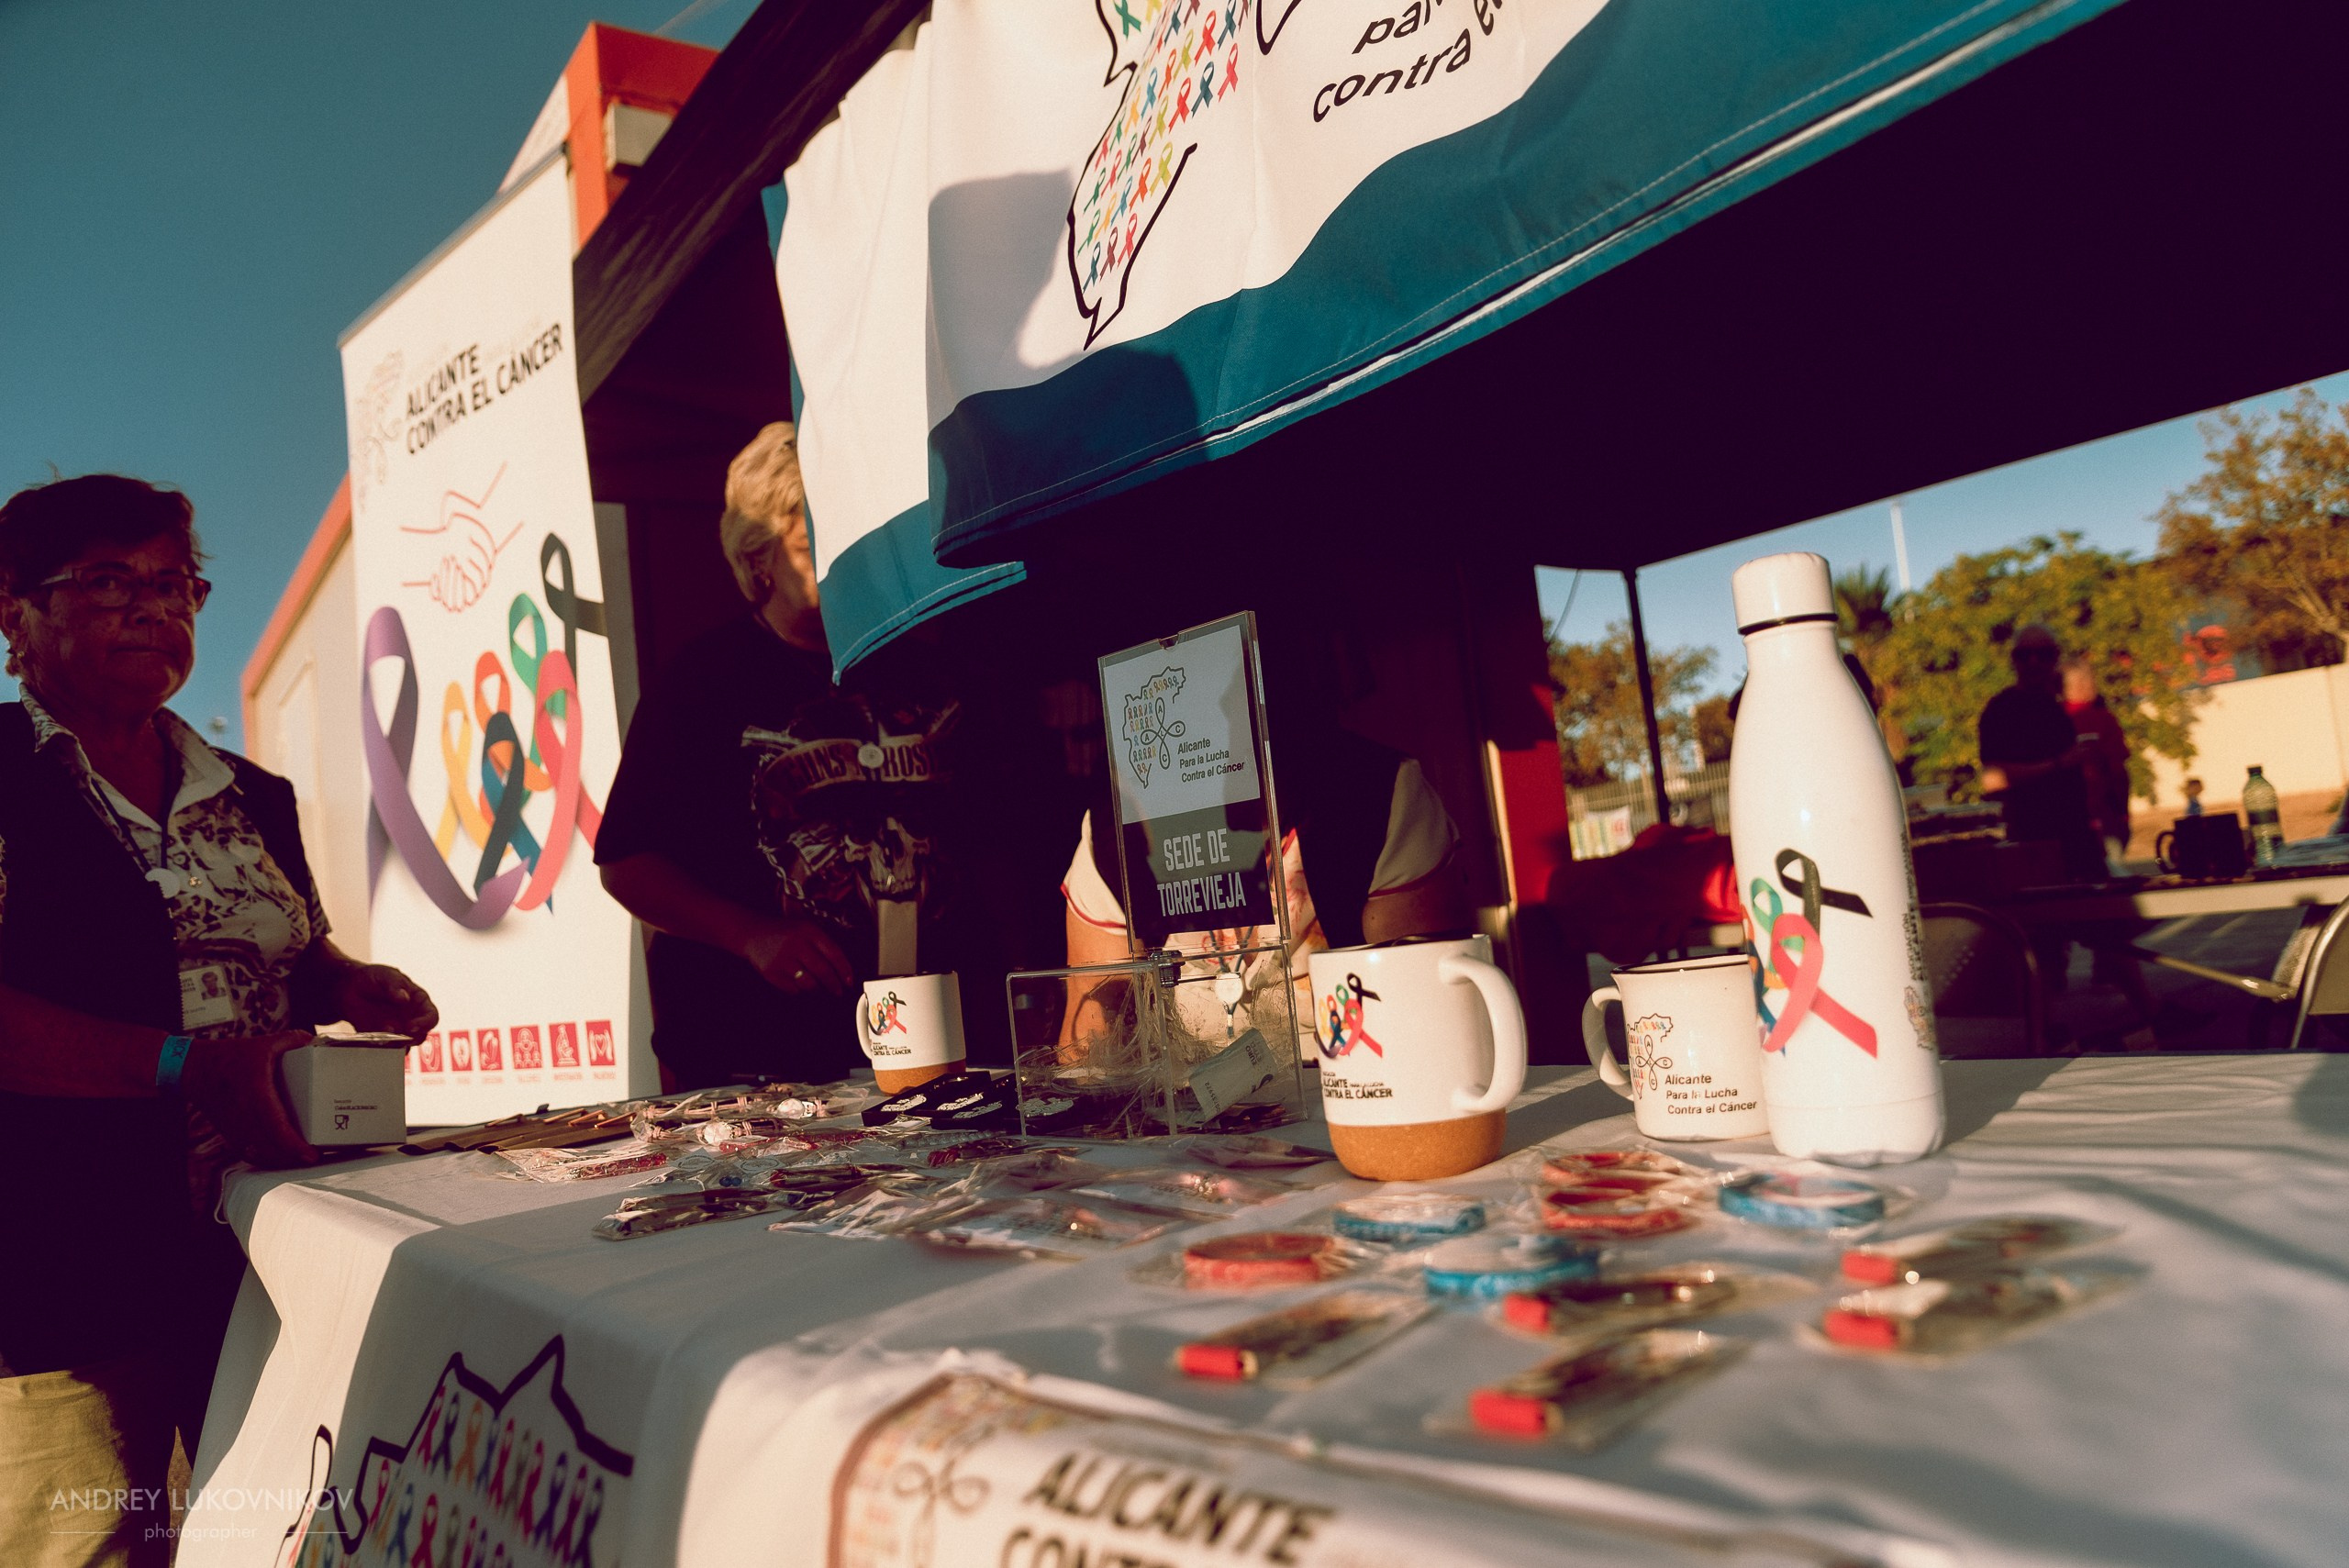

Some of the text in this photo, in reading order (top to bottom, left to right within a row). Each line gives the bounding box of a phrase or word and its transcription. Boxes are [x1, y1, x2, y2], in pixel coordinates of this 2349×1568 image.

[1352, 0, 1442, 54] par
[1313, 28, 1471, 123] contra
[406, 343, 479, 416] ALICANTE
[406, 390, 466, 454] CONTRA
[472, 375, 492, 412] EL
[1177, 738, 1210, 754] Alicante
[1180, 750, 1230, 769] Para la Lucha
[1182, 762, 1244, 783] Contra el Cáncer
[1163, 828, 1230, 872] SEDE DE
[1157, 872, 1247, 917] TORREVIEJA
[1245, 1045, 1257, 1065] EURO
[1664, 1073, 1712, 1084] Alicante
[1345, 1089, 1354, 1099] EL
[1355, 1085, 1393, 1099] CÁNCER
[1666, 1086, 1738, 1100] Para la Lucha
[1667, 1101, 1757, 1114] Contra el Cáncer
[1021, 1451, 1337, 1565] ALICANTE
